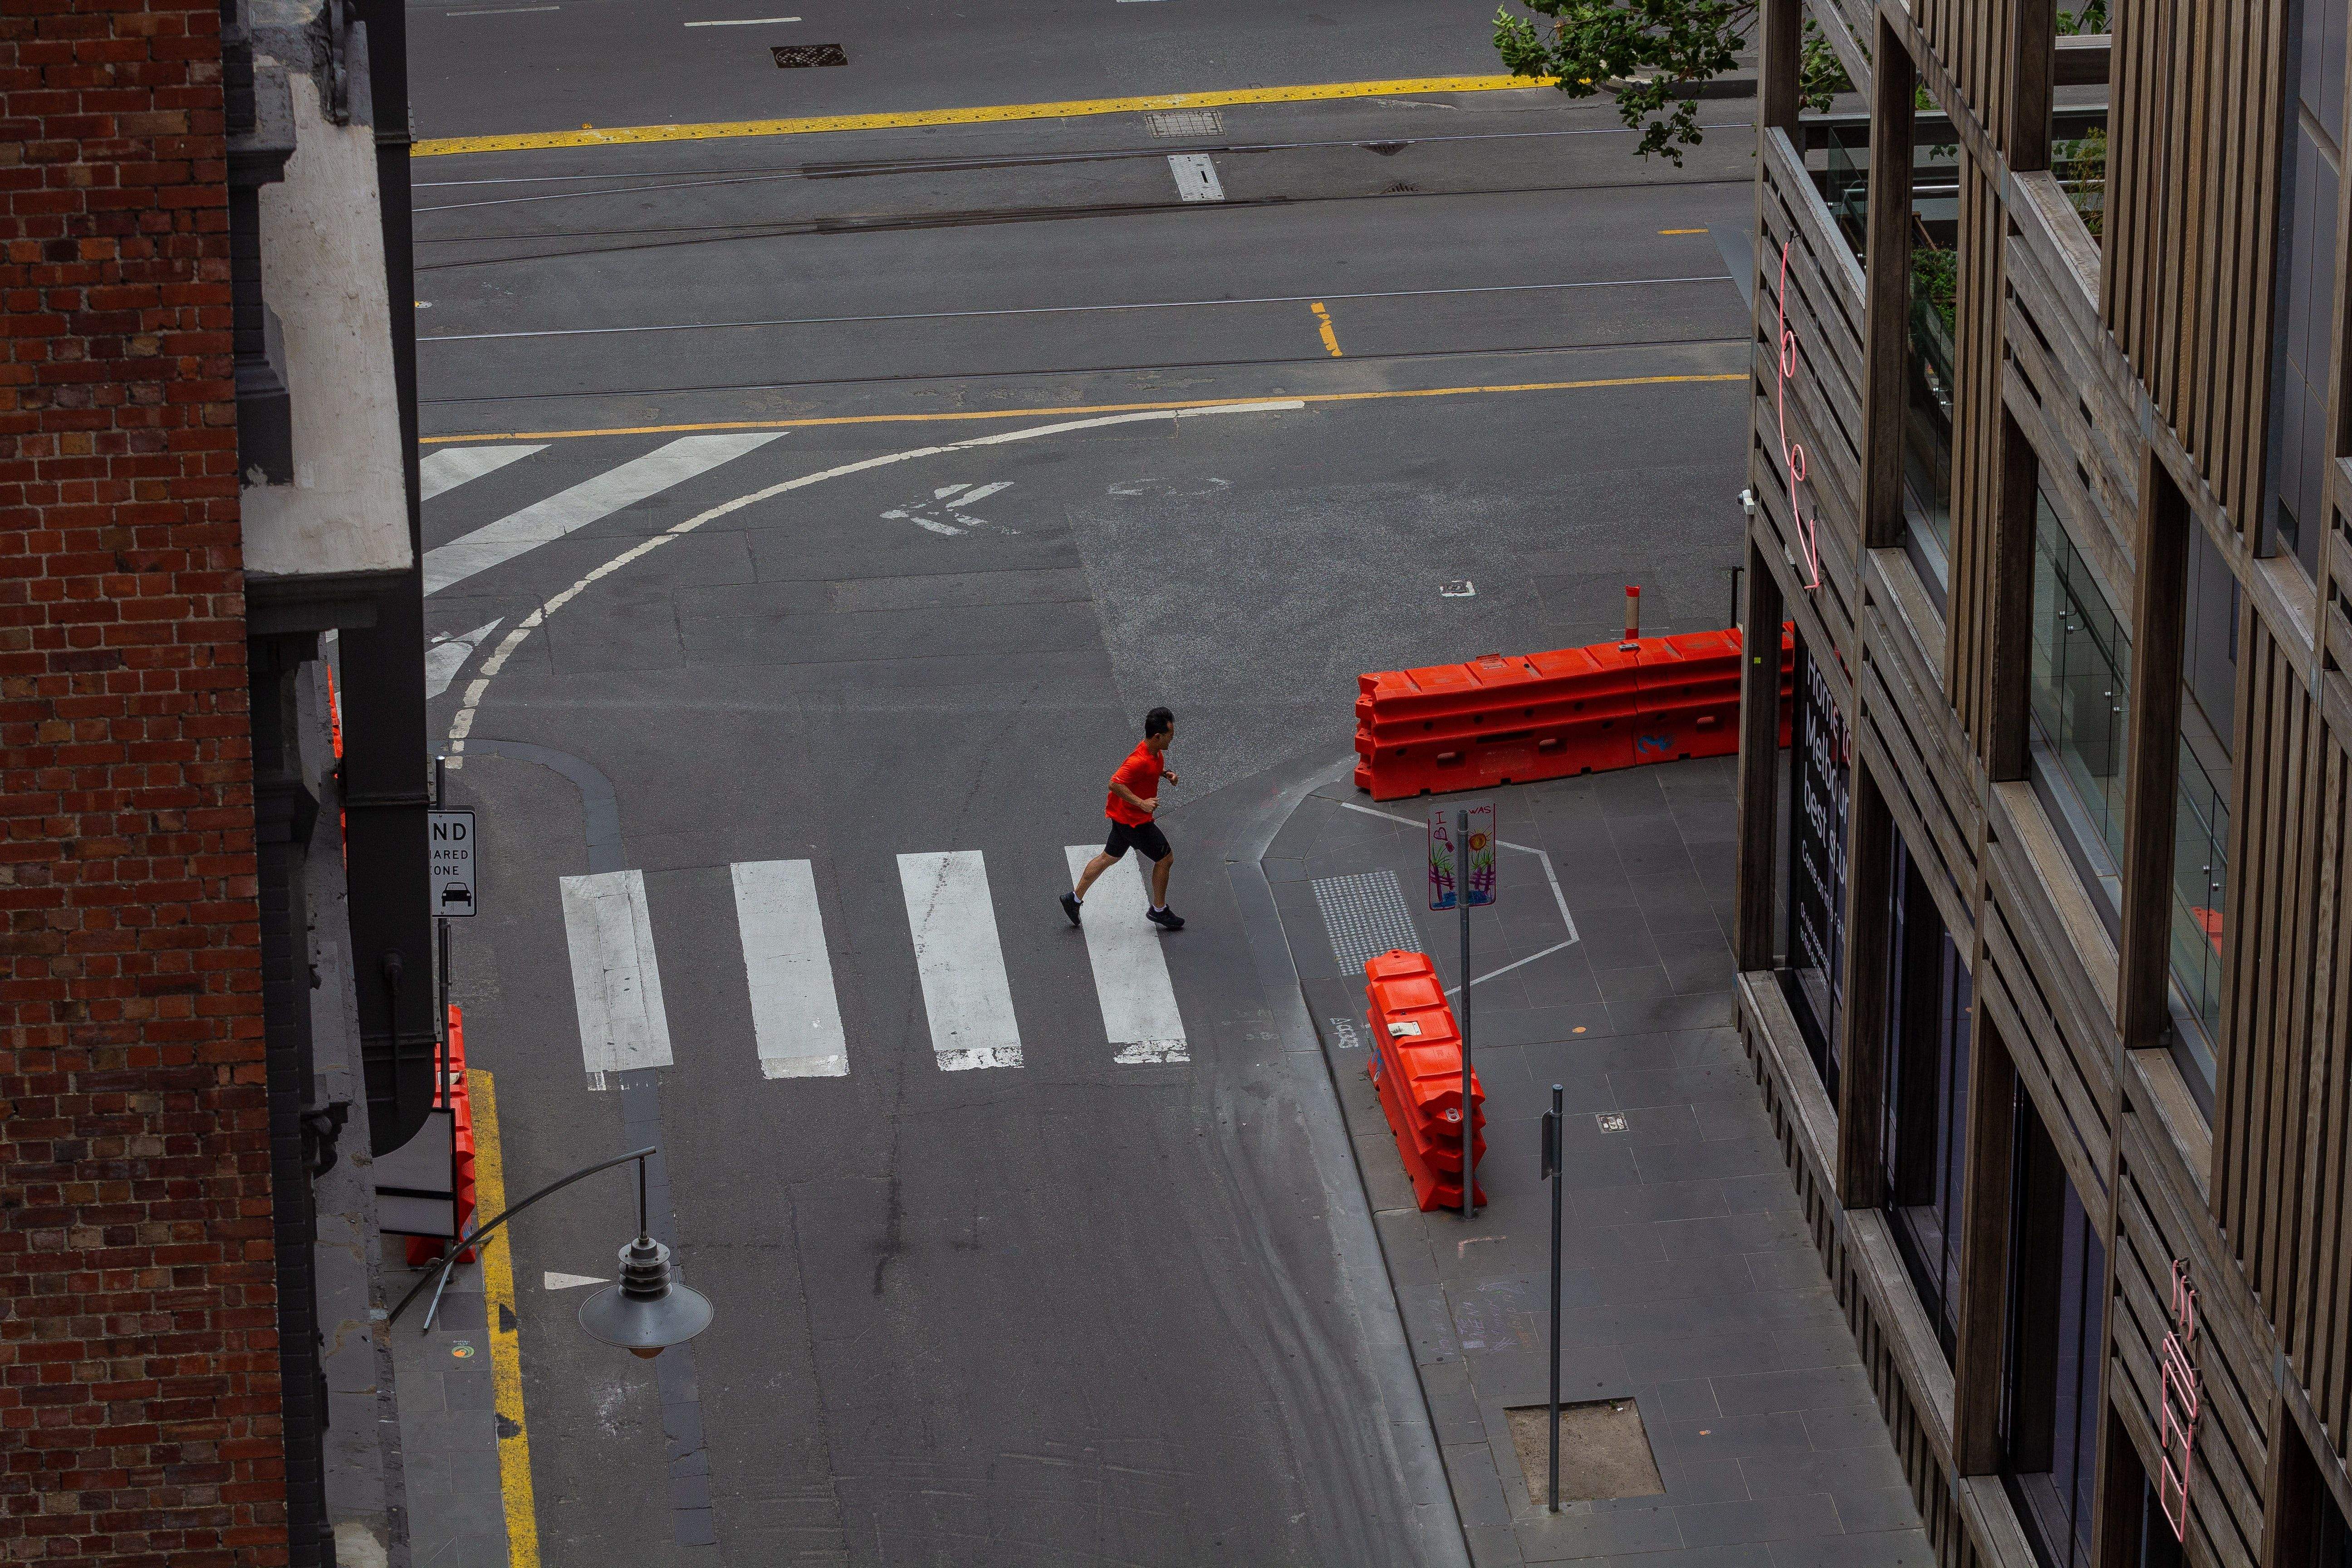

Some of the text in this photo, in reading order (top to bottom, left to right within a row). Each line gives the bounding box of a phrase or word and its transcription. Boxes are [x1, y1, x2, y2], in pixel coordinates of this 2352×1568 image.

[1808, 648, 1838, 740] Home
[1806, 702, 1849, 824] Melbour
[434, 823, 467, 841] ND
[1468, 806, 1491, 814] WAS
[1805, 761, 1847, 888] best stu
[430, 850, 468, 859] ARED
[1802, 839, 1817, 883] Come
[1818, 877, 1823, 899] on
[1824, 886, 1829, 910] in
[1800, 902, 1805, 921] Or
